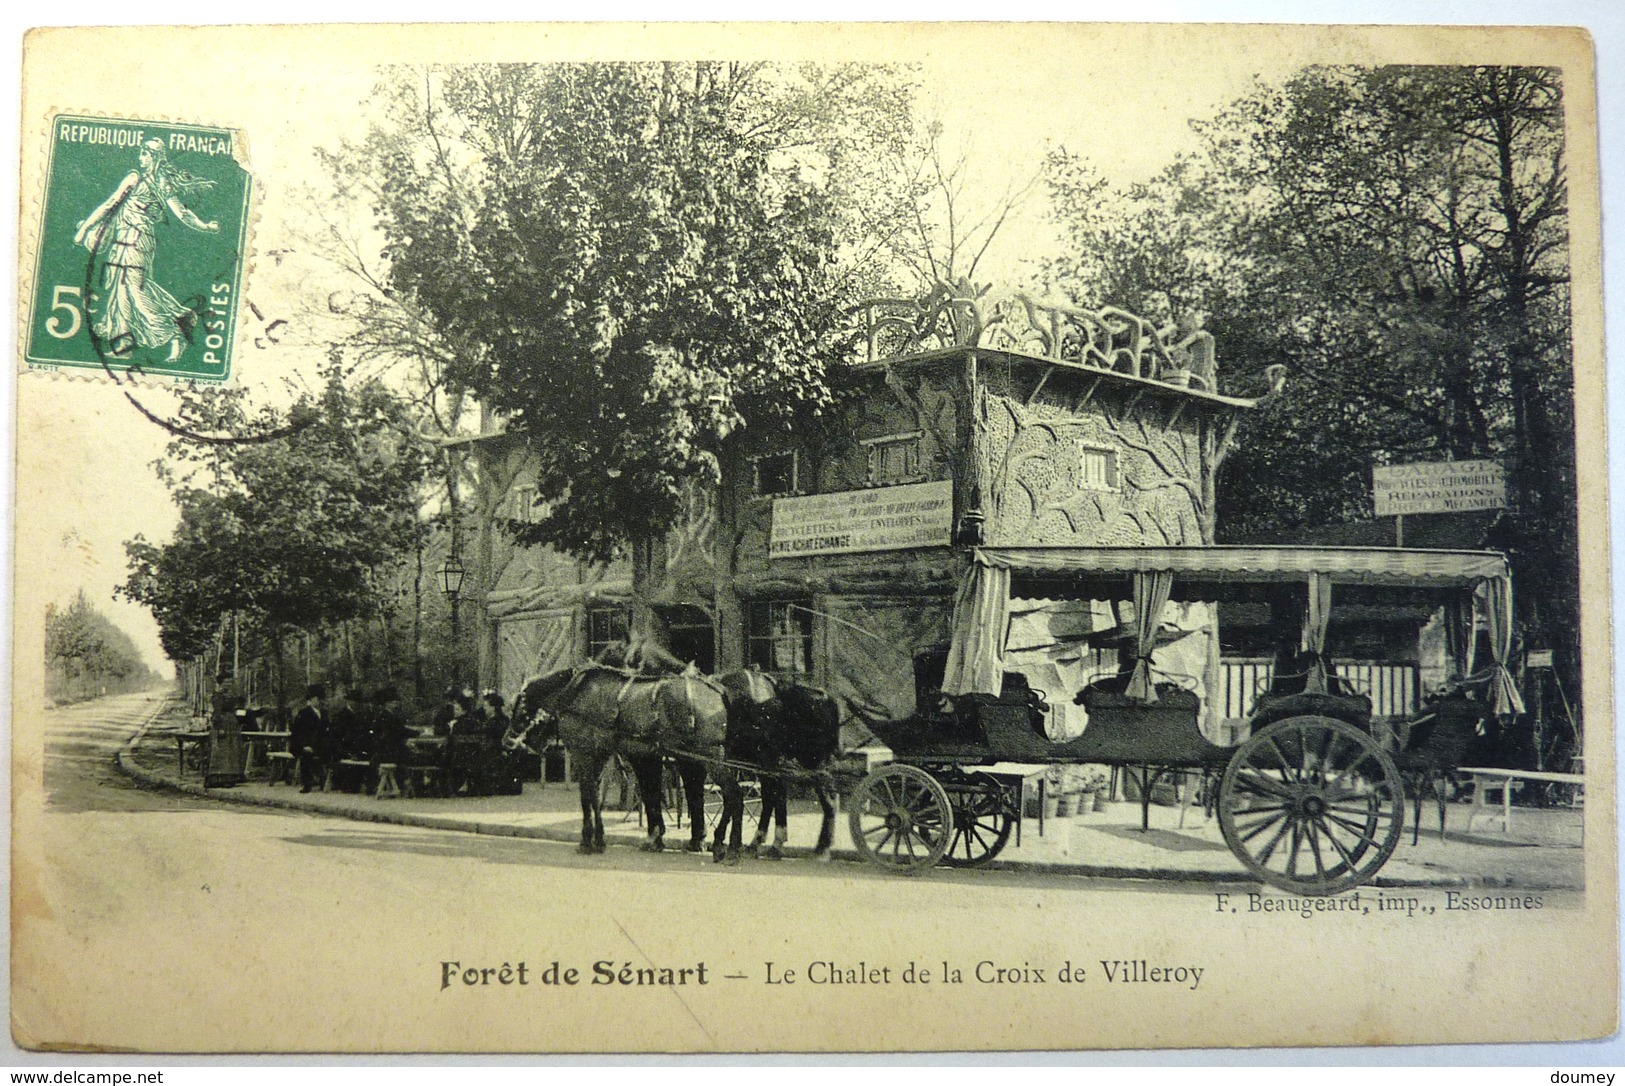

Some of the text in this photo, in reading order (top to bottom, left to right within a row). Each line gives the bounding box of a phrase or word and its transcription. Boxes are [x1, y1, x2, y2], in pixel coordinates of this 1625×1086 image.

[60, 123, 145, 149] REPUBLIQUE
[202, 282, 231, 364] POSTES
[1215, 891, 1544, 918] F. Beaugeard, imp., Essonnes
[440, 960, 530, 991] Forêt
[542, 960, 580, 985] de
[591, 959, 709, 985] Sénart
[764, 961, 796, 985] Le
[807, 960, 891, 985] Chalet
[902, 961, 931, 985] de
[941, 961, 964, 984] la
[975, 960, 1047, 984] Croix
[1058, 960, 1086, 984] de
[1099, 960, 1205, 990] Villeroy
